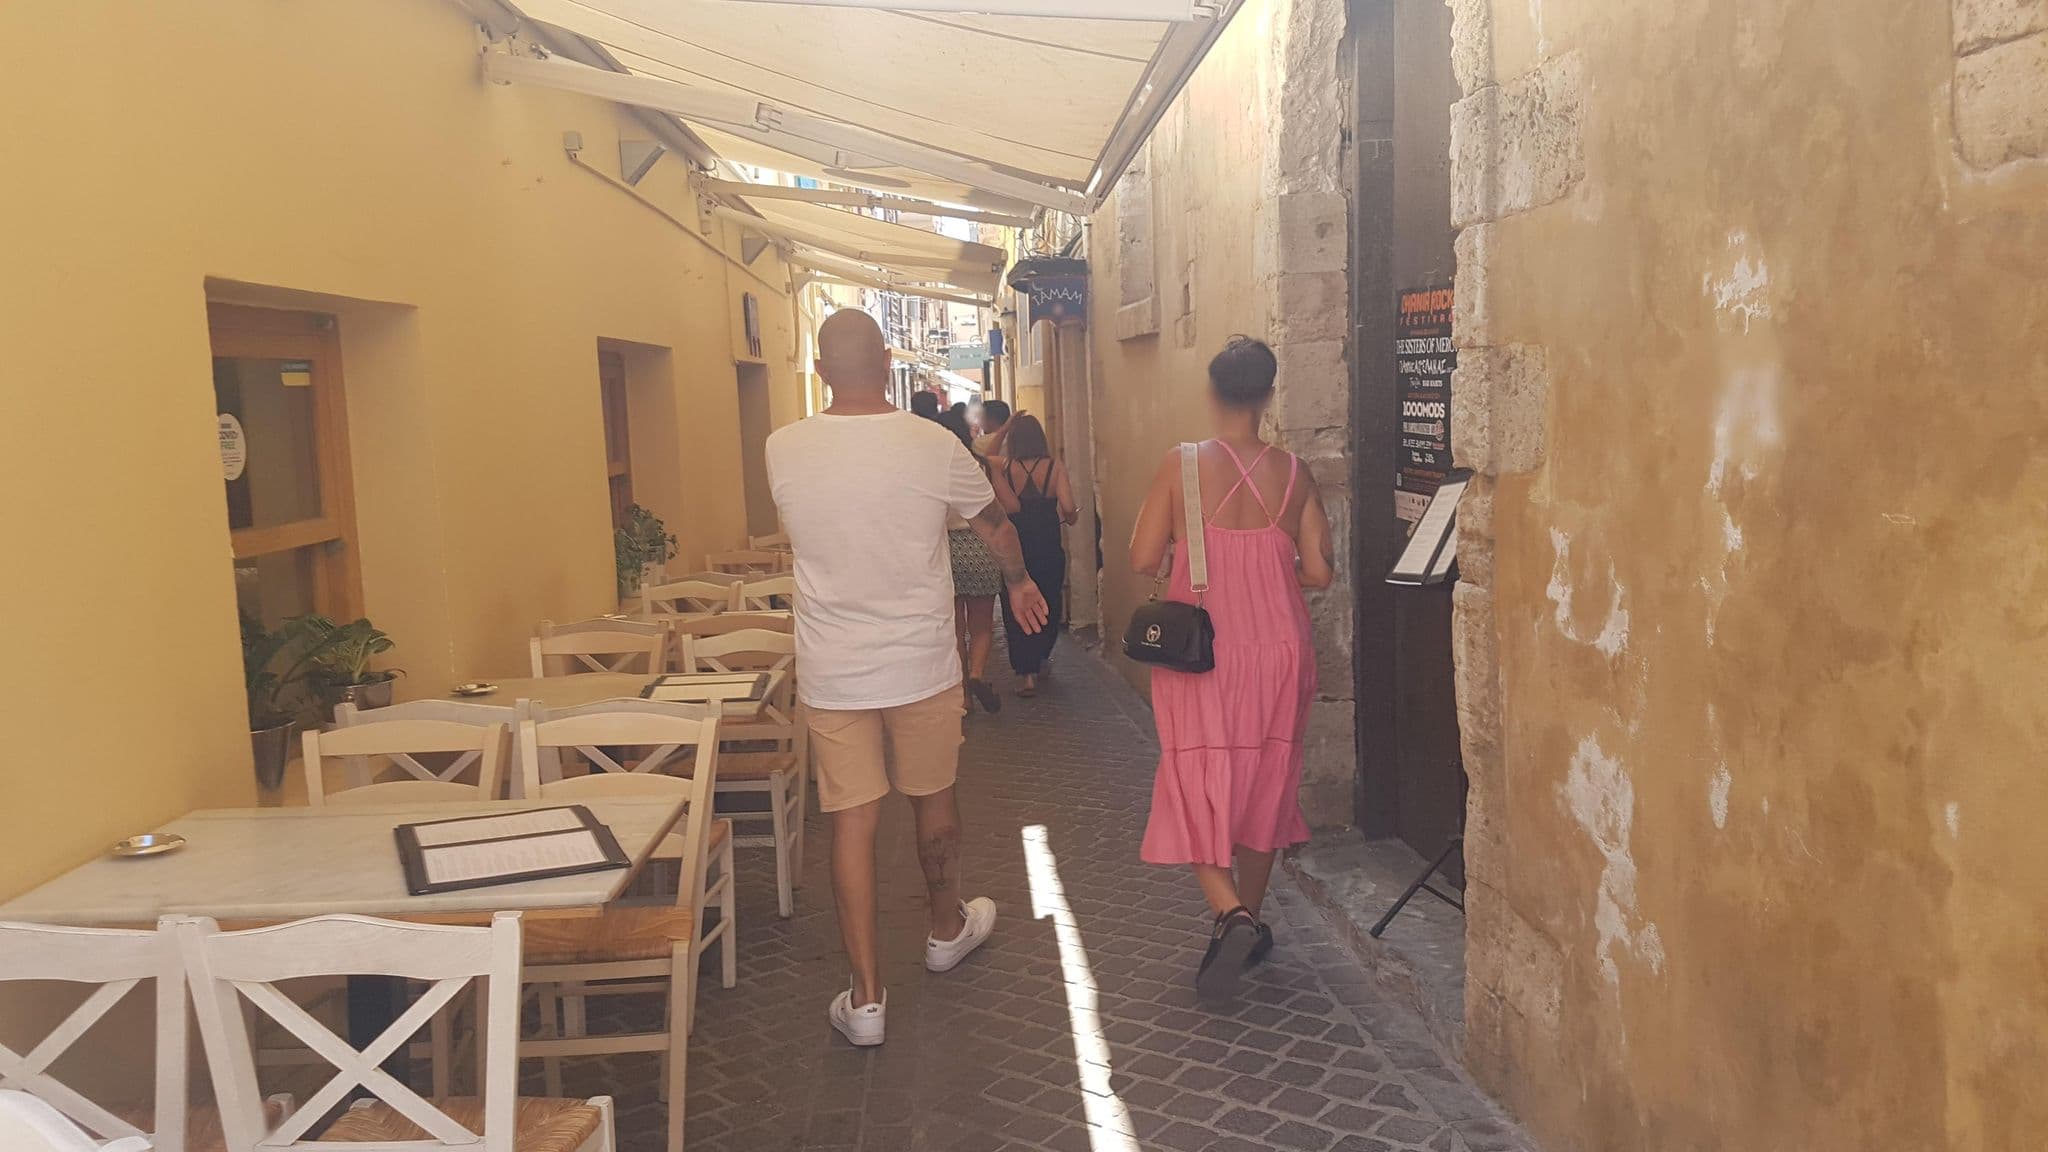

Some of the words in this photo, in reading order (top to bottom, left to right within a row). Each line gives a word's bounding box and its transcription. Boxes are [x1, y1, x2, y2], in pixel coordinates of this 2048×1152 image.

[1031, 287, 1082, 305] TAMAM
[1431, 288, 1454, 313] ROCK
[1396, 339, 1405, 354] THE
[1405, 338, 1426, 354] SISTERS
[1426, 337, 1435, 353] OF
[1402, 401, 1445, 418] 1000MODS
